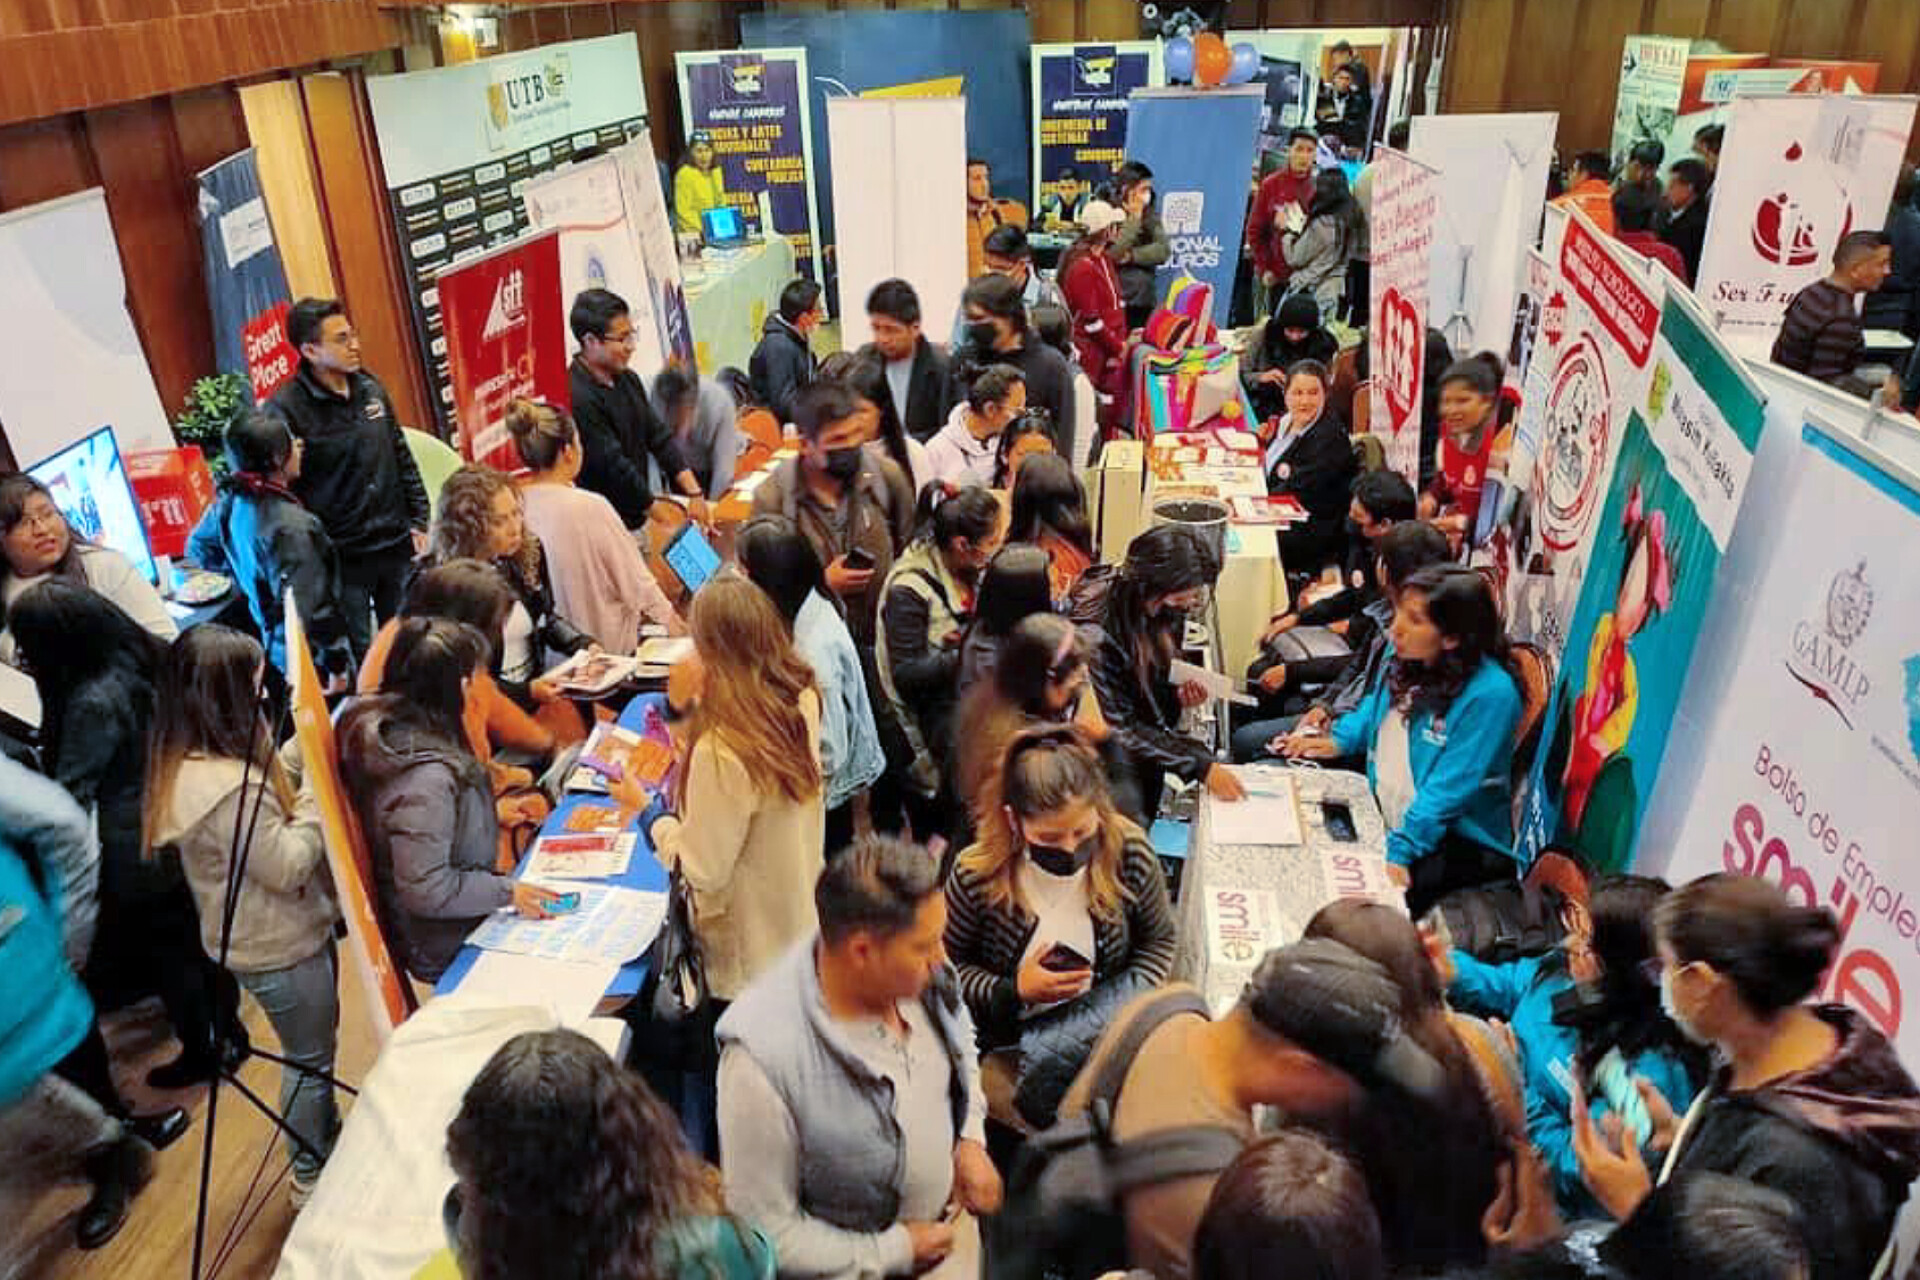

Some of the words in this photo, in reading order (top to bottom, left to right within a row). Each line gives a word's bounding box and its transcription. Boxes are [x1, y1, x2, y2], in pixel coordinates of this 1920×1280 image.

[506, 74, 545, 109] UTB
[1754, 743, 1807, 817] Bolsa
[1808, 812, 1840, 855] de
[1217, 891, 1262, 961] smile
